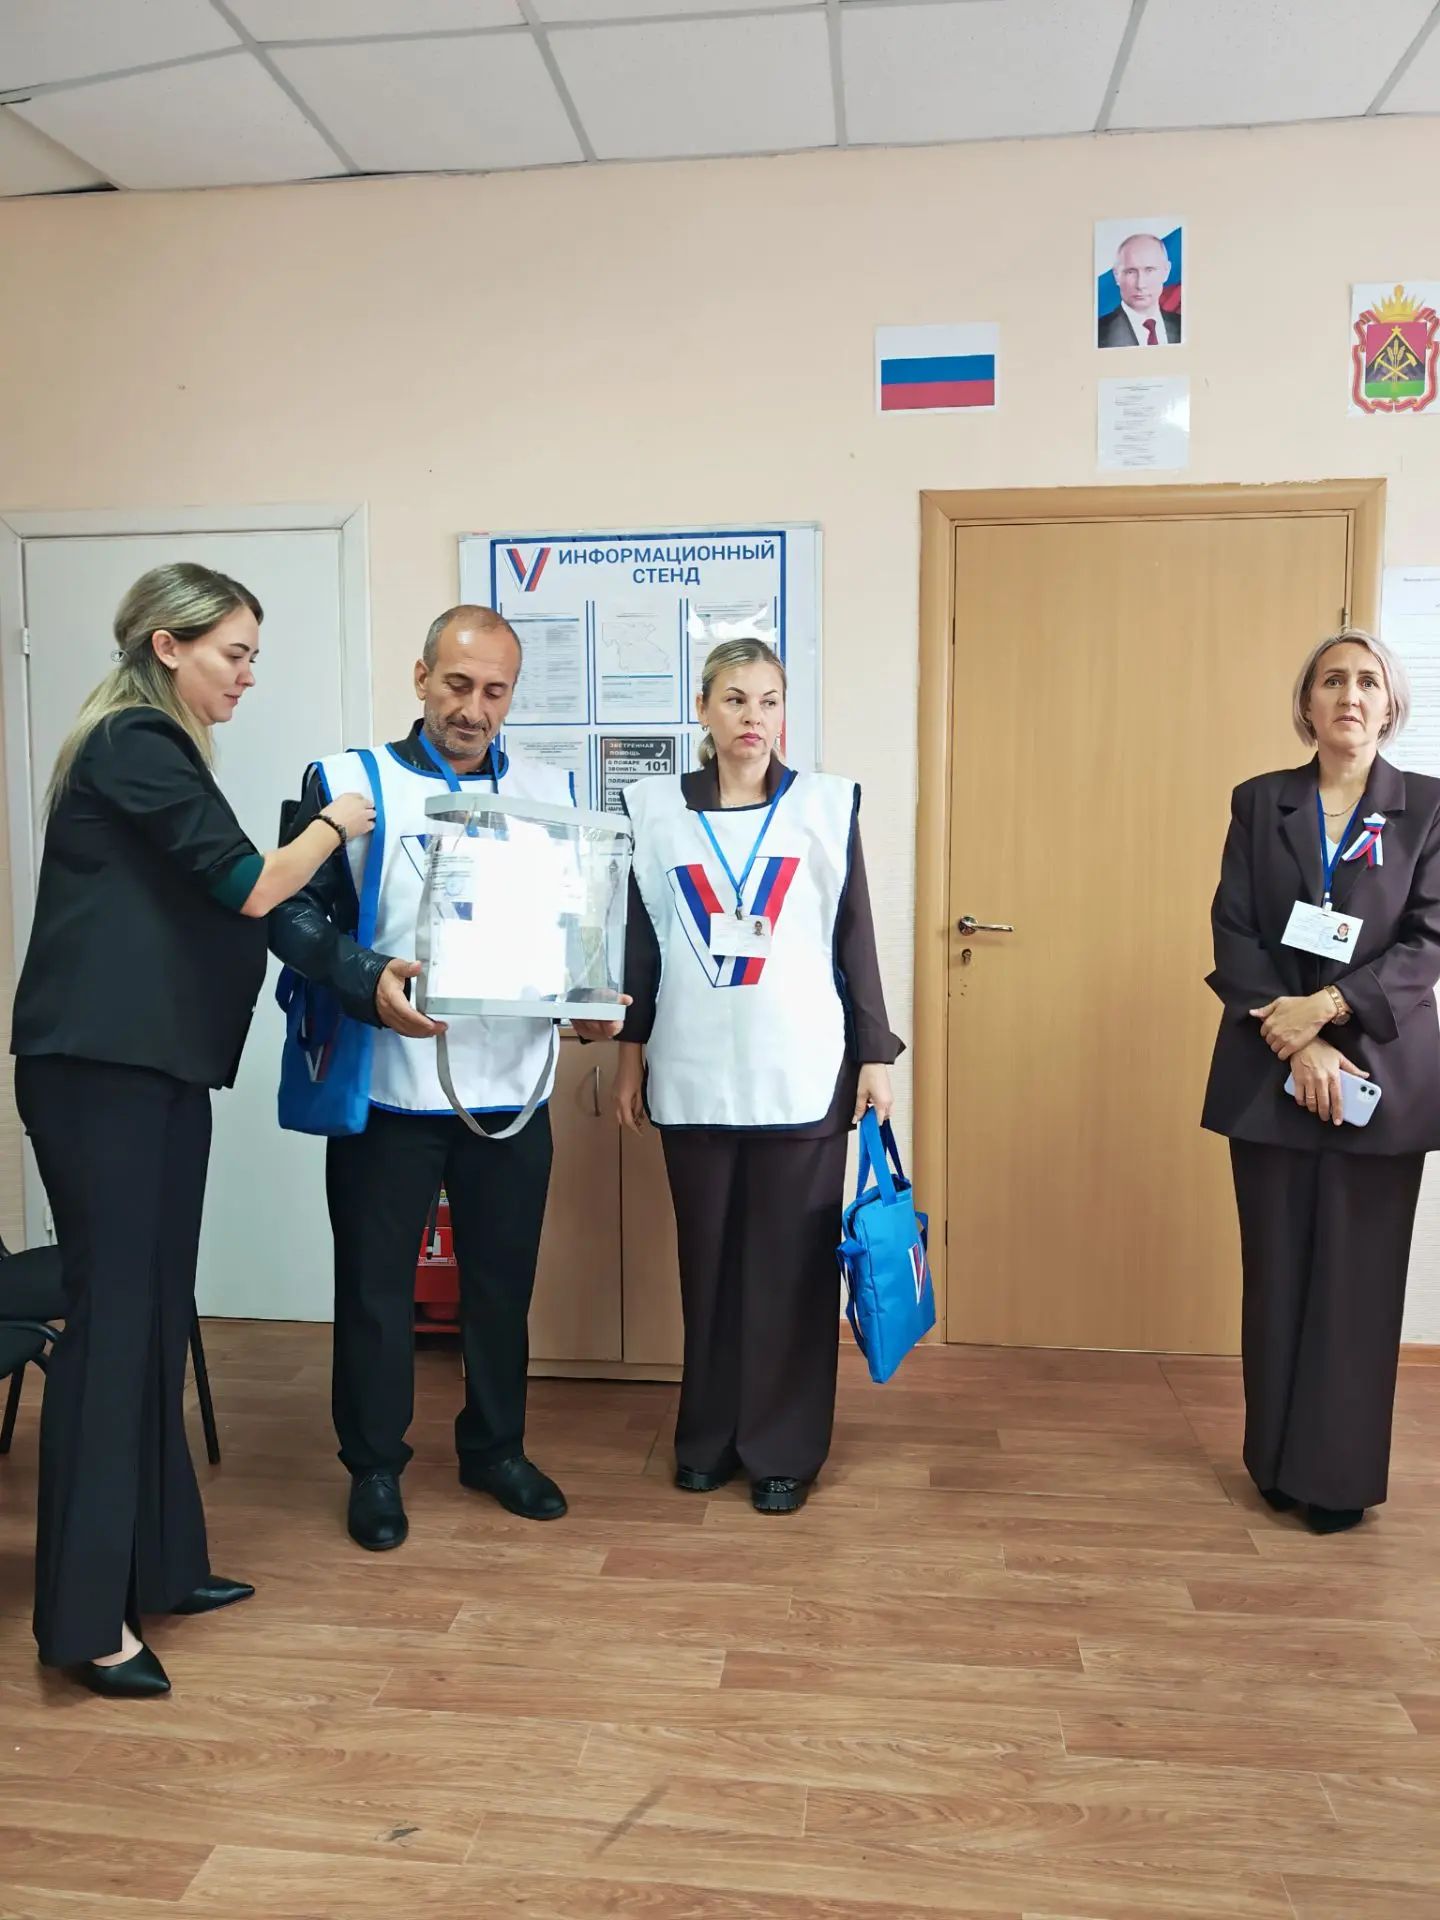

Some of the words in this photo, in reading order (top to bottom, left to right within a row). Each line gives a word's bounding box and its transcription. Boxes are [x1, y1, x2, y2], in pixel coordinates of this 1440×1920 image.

[558, 540, 775, 565] ИНФОРМАЦИОННЫЙ
[632, 566, 701, 586] СТЕНД
[645, 761, 668, 771] 101
